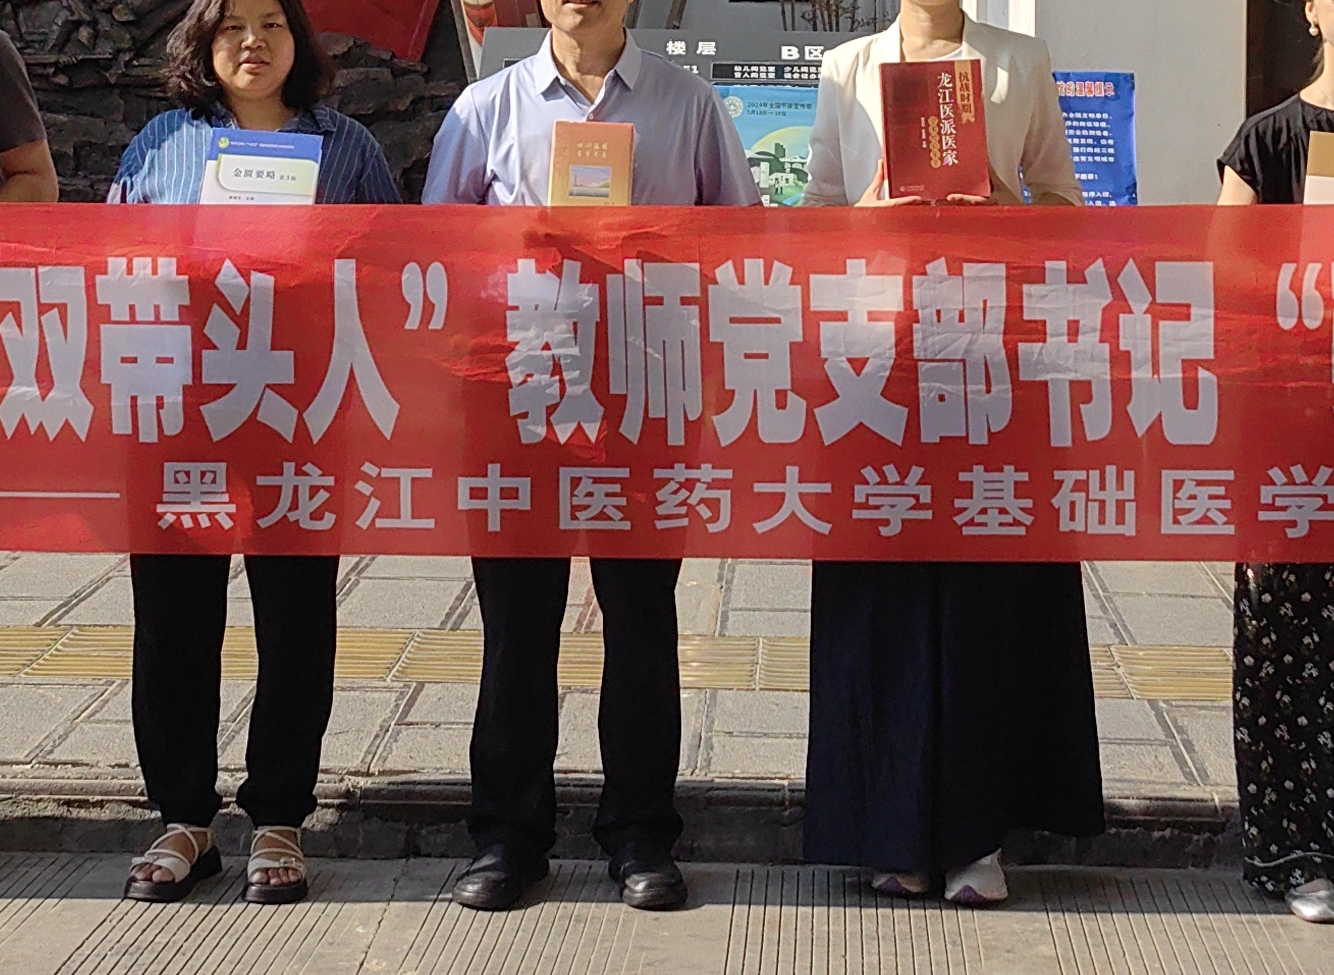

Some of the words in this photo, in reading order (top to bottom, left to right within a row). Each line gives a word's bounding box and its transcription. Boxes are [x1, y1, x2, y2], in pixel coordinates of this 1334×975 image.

[666, 40, 717, 56] 楼层
[936, 72, 959, 166] 龙江医派医家
